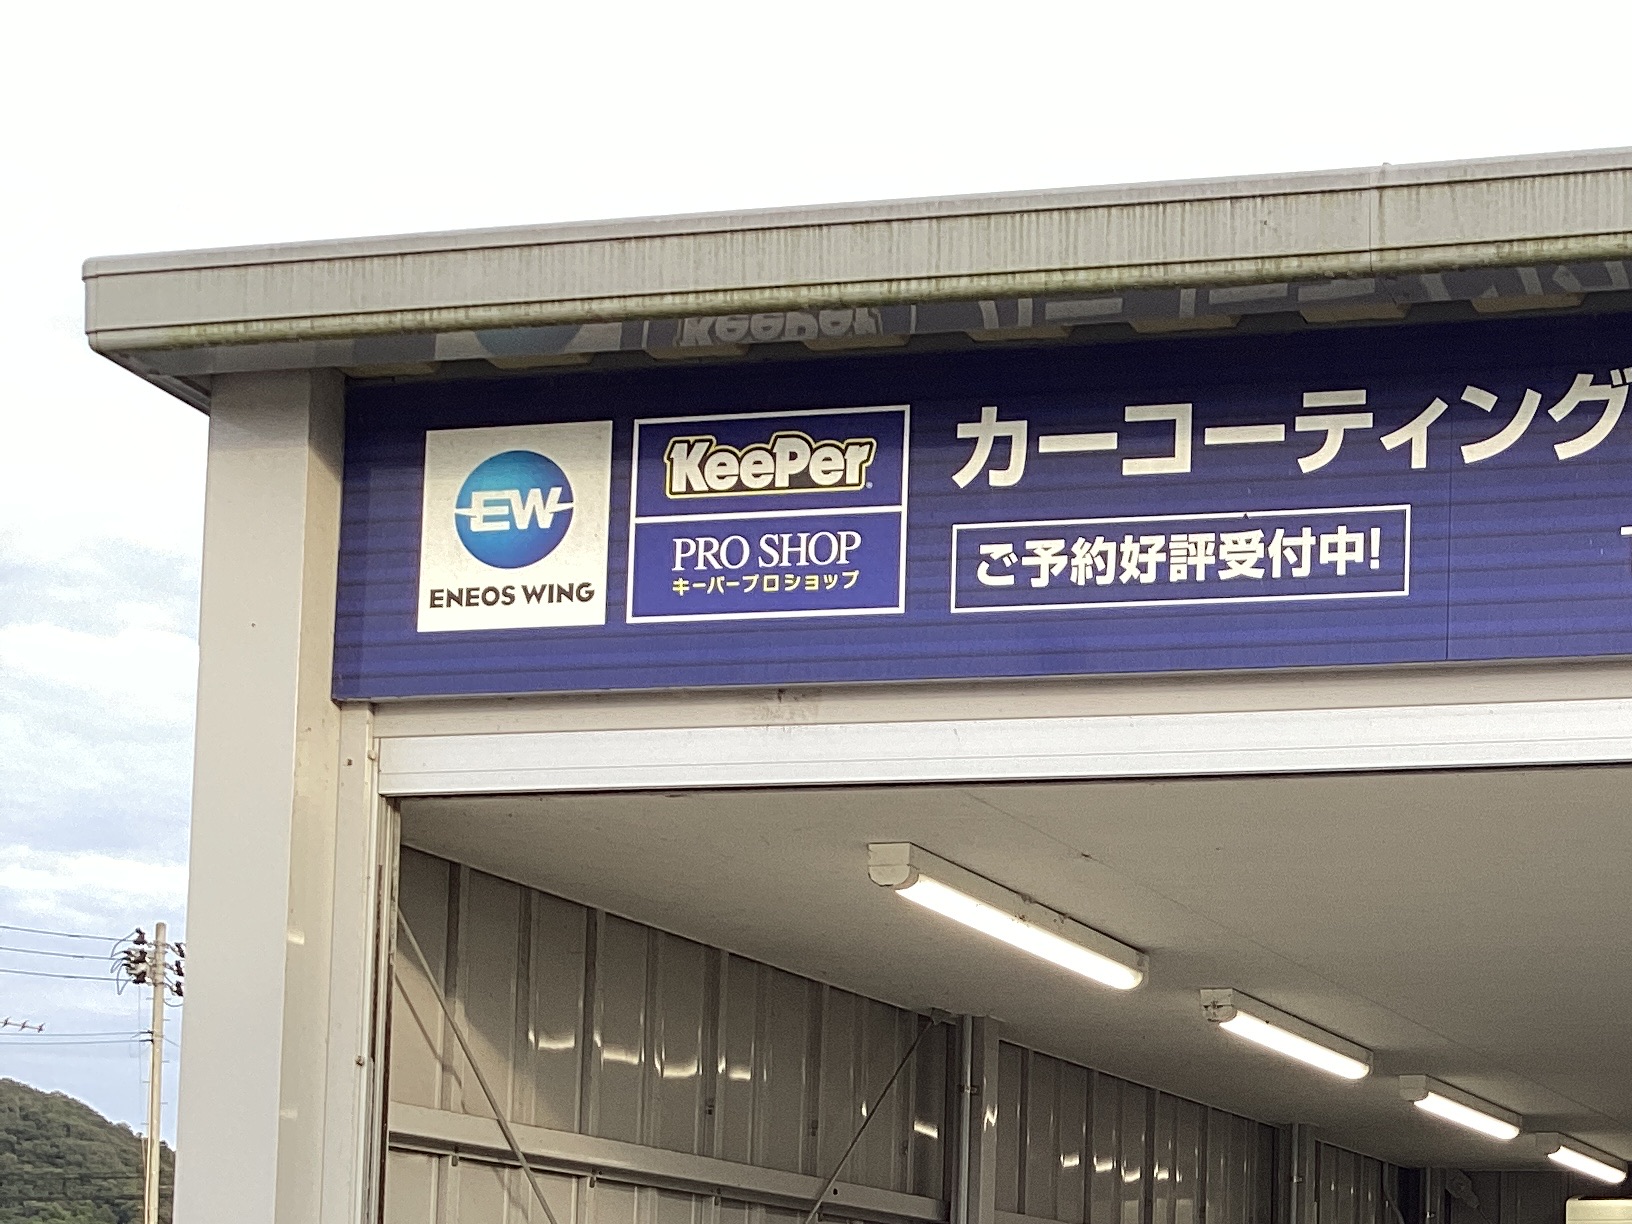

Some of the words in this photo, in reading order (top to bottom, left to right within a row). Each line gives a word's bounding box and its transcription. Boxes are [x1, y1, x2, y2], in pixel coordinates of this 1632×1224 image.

[666, 431, 876, 499] KeePer
[470, 486, 562, 533] EW
[671, 535, 750, 573] PRO
[757, 530, 863, 569] SHOP
[976, 526, 1382, 588] ご予約好評受付中!
[429, 584, 516, 610] ENEOS
[524, 581, 596, 605] WING
[671, 569, 861, 597] キーパープロショップ
